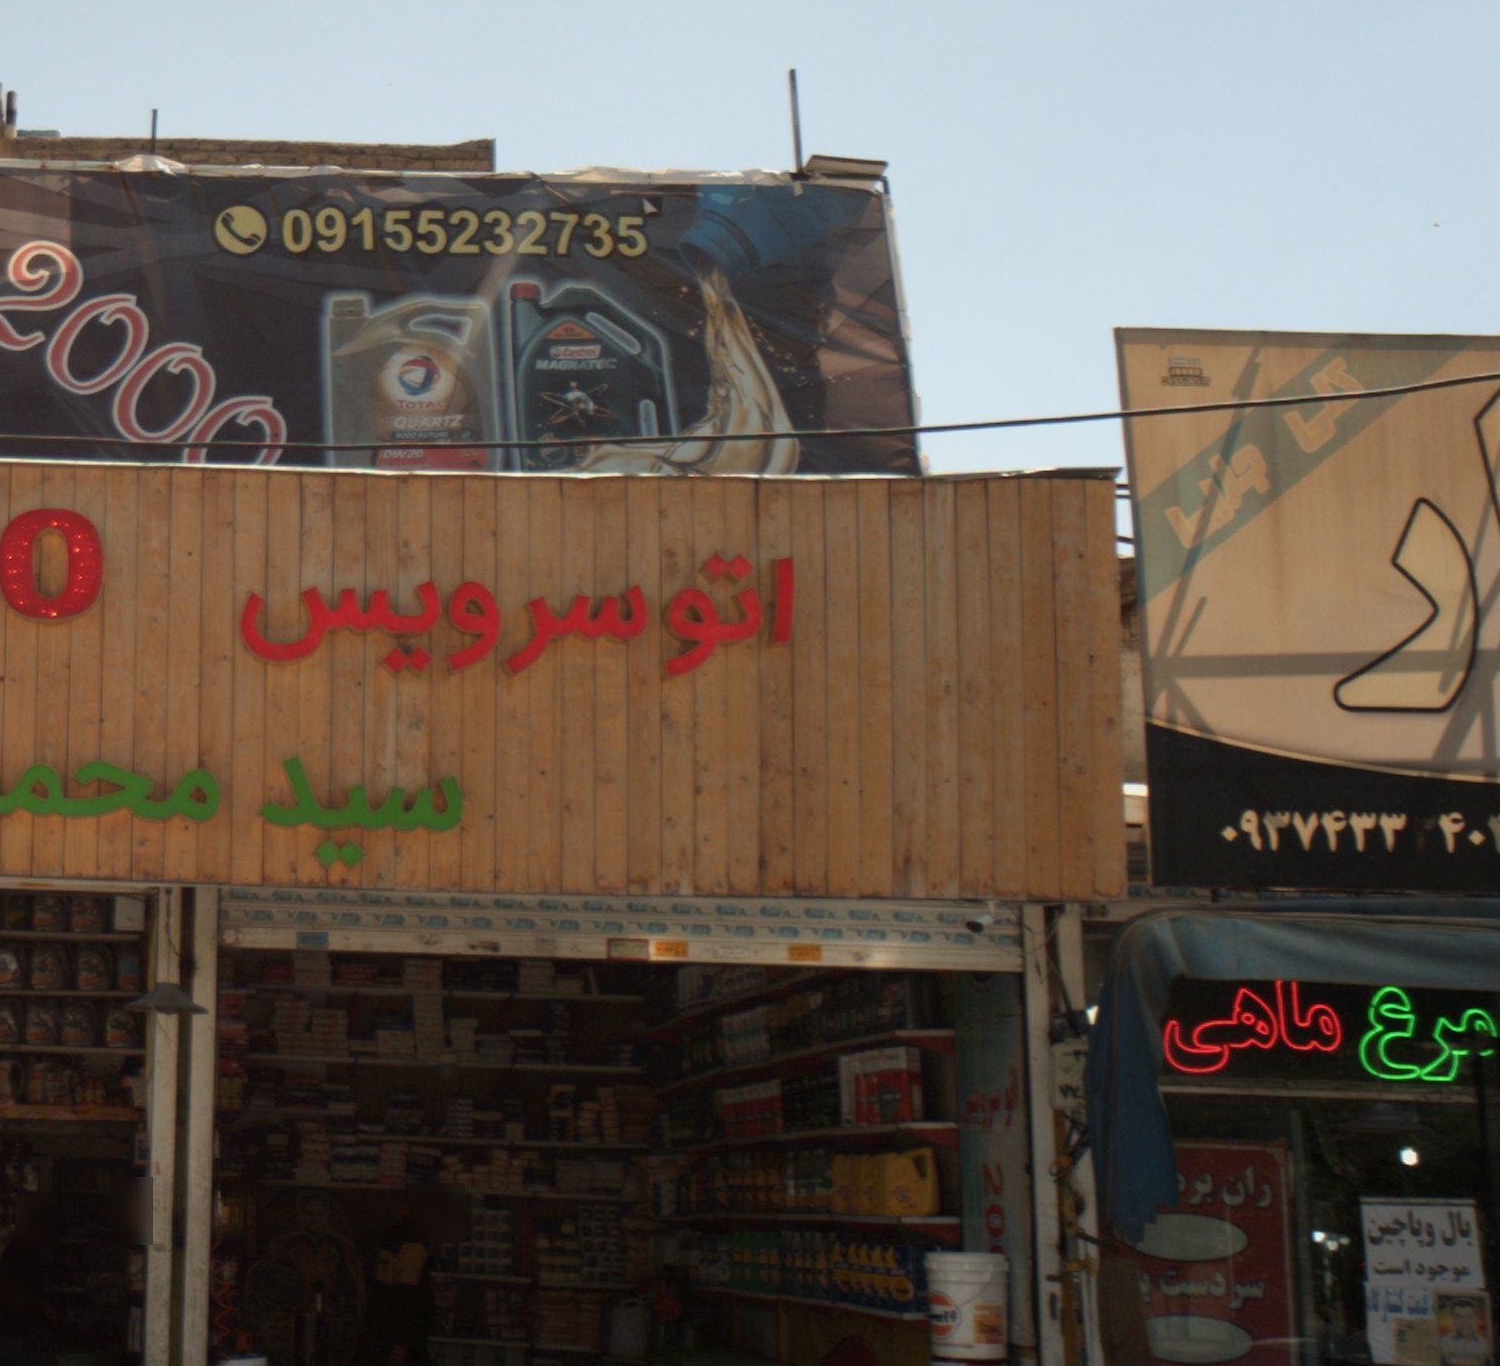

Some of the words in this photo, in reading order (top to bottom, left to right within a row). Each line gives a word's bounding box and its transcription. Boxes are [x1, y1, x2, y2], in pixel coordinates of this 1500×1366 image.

[280, 208, 650, 259] 09155232735
[394, 415, 464, 430] QUARTZ
[240, 553, 794, 675] اتوسرویس
[260, 757, 464, 867] سید
[1162, 979, 1342, 1075] ماهی
[1221, 1165, 1273, 1209] ران
[1442, 1210, 1472, 1247] بال
